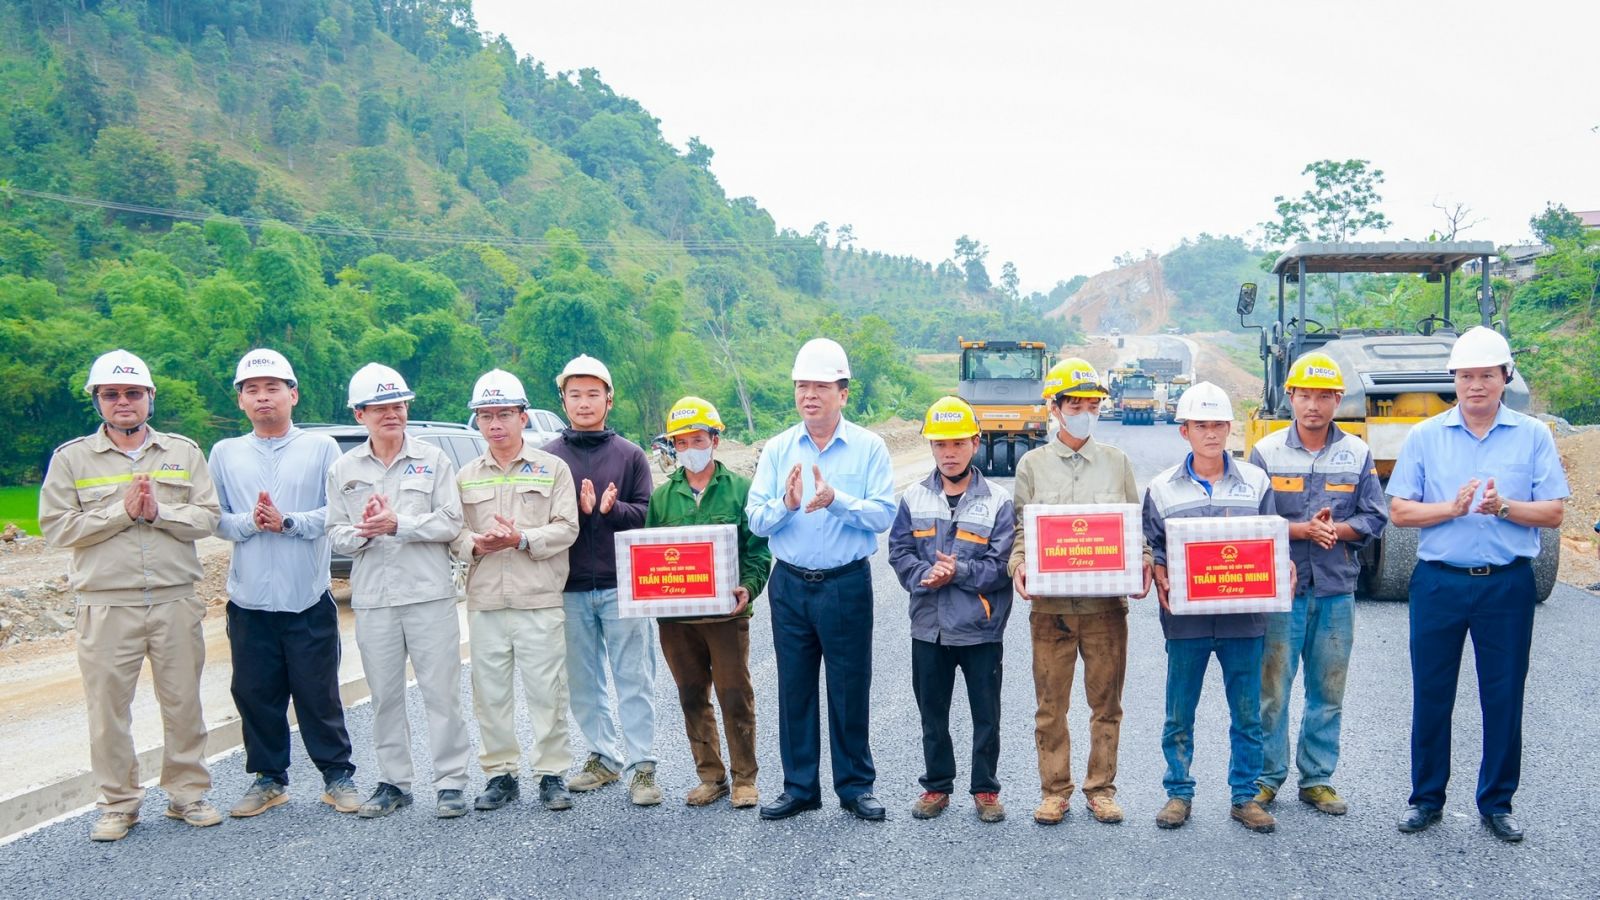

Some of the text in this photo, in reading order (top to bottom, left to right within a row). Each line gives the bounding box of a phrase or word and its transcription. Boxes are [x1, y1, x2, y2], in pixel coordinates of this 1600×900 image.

[1044, 544, 1118, 556] TRẦN HỒNG MINH
[1067, 557, 1095, 567] Tặng
[639, 572, 708, 584] TRẦN HỒNG MINH
[1193, 571, 1268, 584] TRẦN HỒNG MINH
[661, 585, 686, 594] Tặng
[1217, 585, 1245, 593] Tặng
